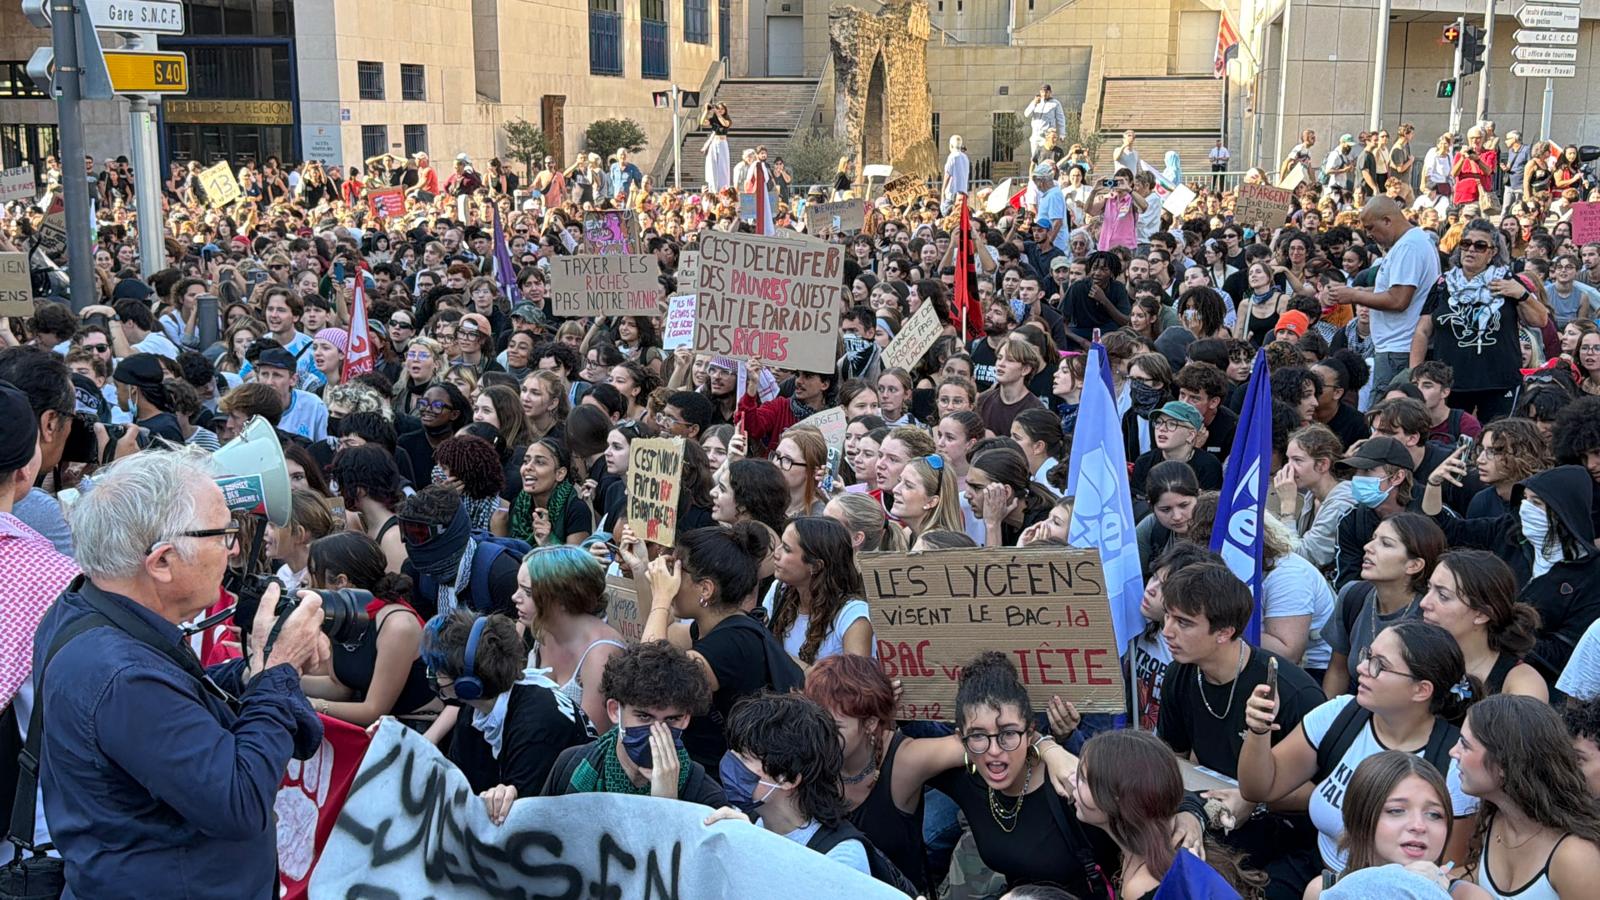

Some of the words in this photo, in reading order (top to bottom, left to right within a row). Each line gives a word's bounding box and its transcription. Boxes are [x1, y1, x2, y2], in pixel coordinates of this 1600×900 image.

[109, 4, 134, 21] Gare
[141, 10, 179, 25] S.N.C.F.
[156, 63, 163, 83] S
[165, 64, 181, 83] 40
[1554, 67, 1574, 75] Travail
[210, 175, 233, 195] 13
[701, 234, 741, 265] C'EST
[561, 256, 610, 276] TAXER
[619, 256, 648, 274] LES
[585, 274, 630, 290] RICHES
[700, 264, 725, 292] DES
[730, 268, 792, 306] PAUVRES
[555, 293, 581, 310] PAS
[587, 293, 626, 310] NOTRE
[627, 291, 659, 310] AVENIR
[698, 292, 738, 324] FAIT
[738, 298, 761, 328] LE
[761, 303, 833, 333] PARADIS
[917, 316, 933, 337] PAS
[696, 323, 733, 355] DES
[731, 327, 789, 361] RICHES
[873, 565, 928, 599] LES
[944, 556, 1101, 598] LYCÉENS
[968, 604, 992, 623] LE
[1066, 605, 1089, 628] la
[877, 640, 936, 679] BAC
[1013, 641, 1113, 685] TÊTE
[1320, 777, 1343, 810] TAL
